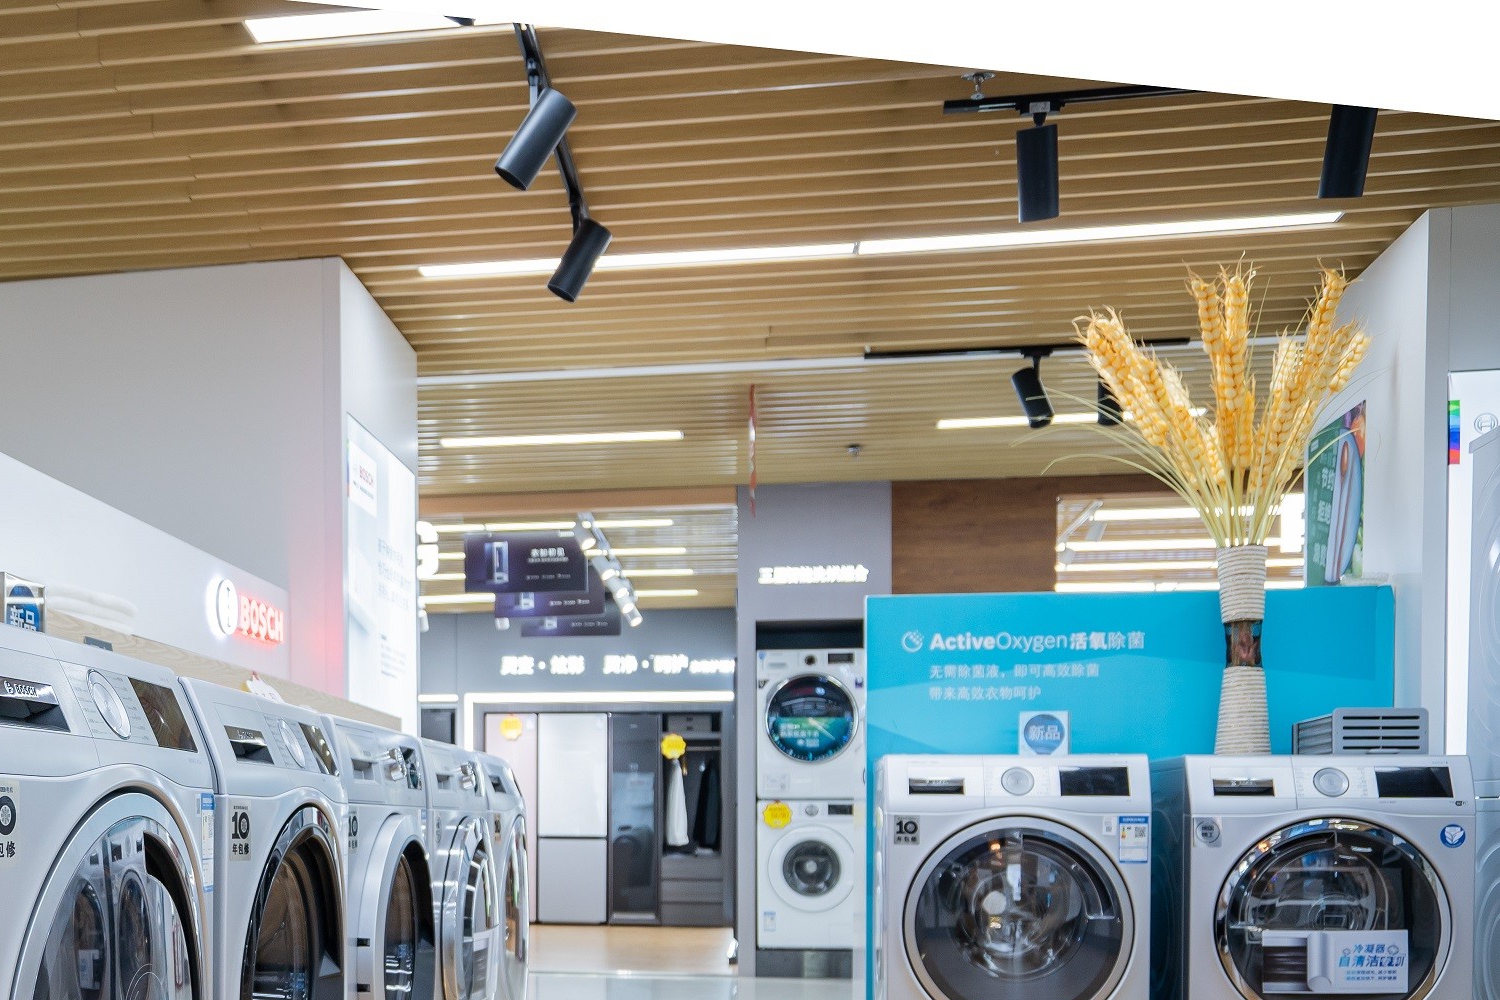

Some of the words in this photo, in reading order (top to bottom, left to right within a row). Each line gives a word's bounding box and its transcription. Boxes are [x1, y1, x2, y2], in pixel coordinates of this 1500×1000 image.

[240, 594, 284, 643] BOSCH
[1027, 724, 1061, 741] 新品
[231, 811, 250, 840] 10
[896, 820, 919, 835] 10
